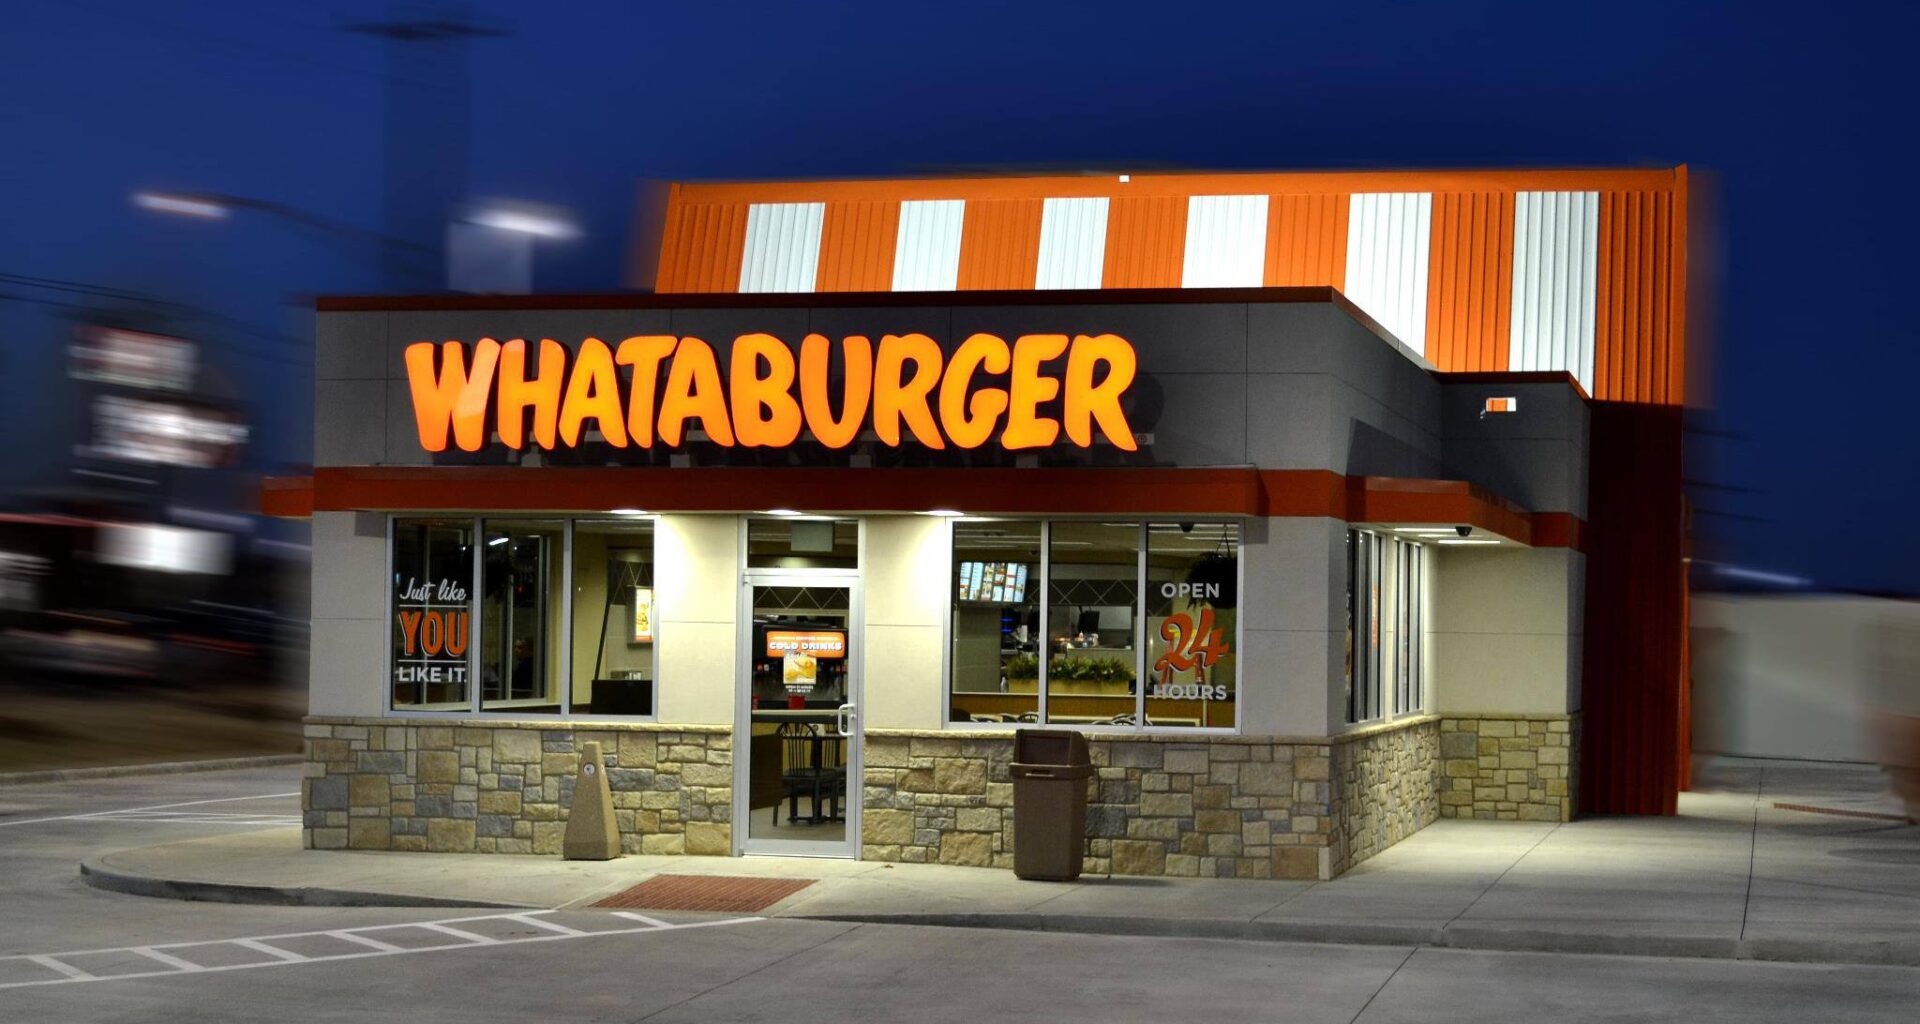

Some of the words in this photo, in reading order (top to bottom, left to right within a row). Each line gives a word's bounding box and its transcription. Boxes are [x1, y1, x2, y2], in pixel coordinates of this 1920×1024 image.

[404, 333, 1138, 452] WHATABURGER
[399, 577, 436, 601] Just
[438, 578, 467, 600] like
[1161, 582, 1220, 598] OPEN
[398, 610, 469, 657] YOU
[1153, 607, 1229, 672] 24
[769, 641, 799, 650] COLD
[801, 641, 843, 650] DRINKS
[399, 666, 442, 683] LIKE
[447, 667, 467, 683] IT.
[1153, 684, 1227, 700] HOURS
